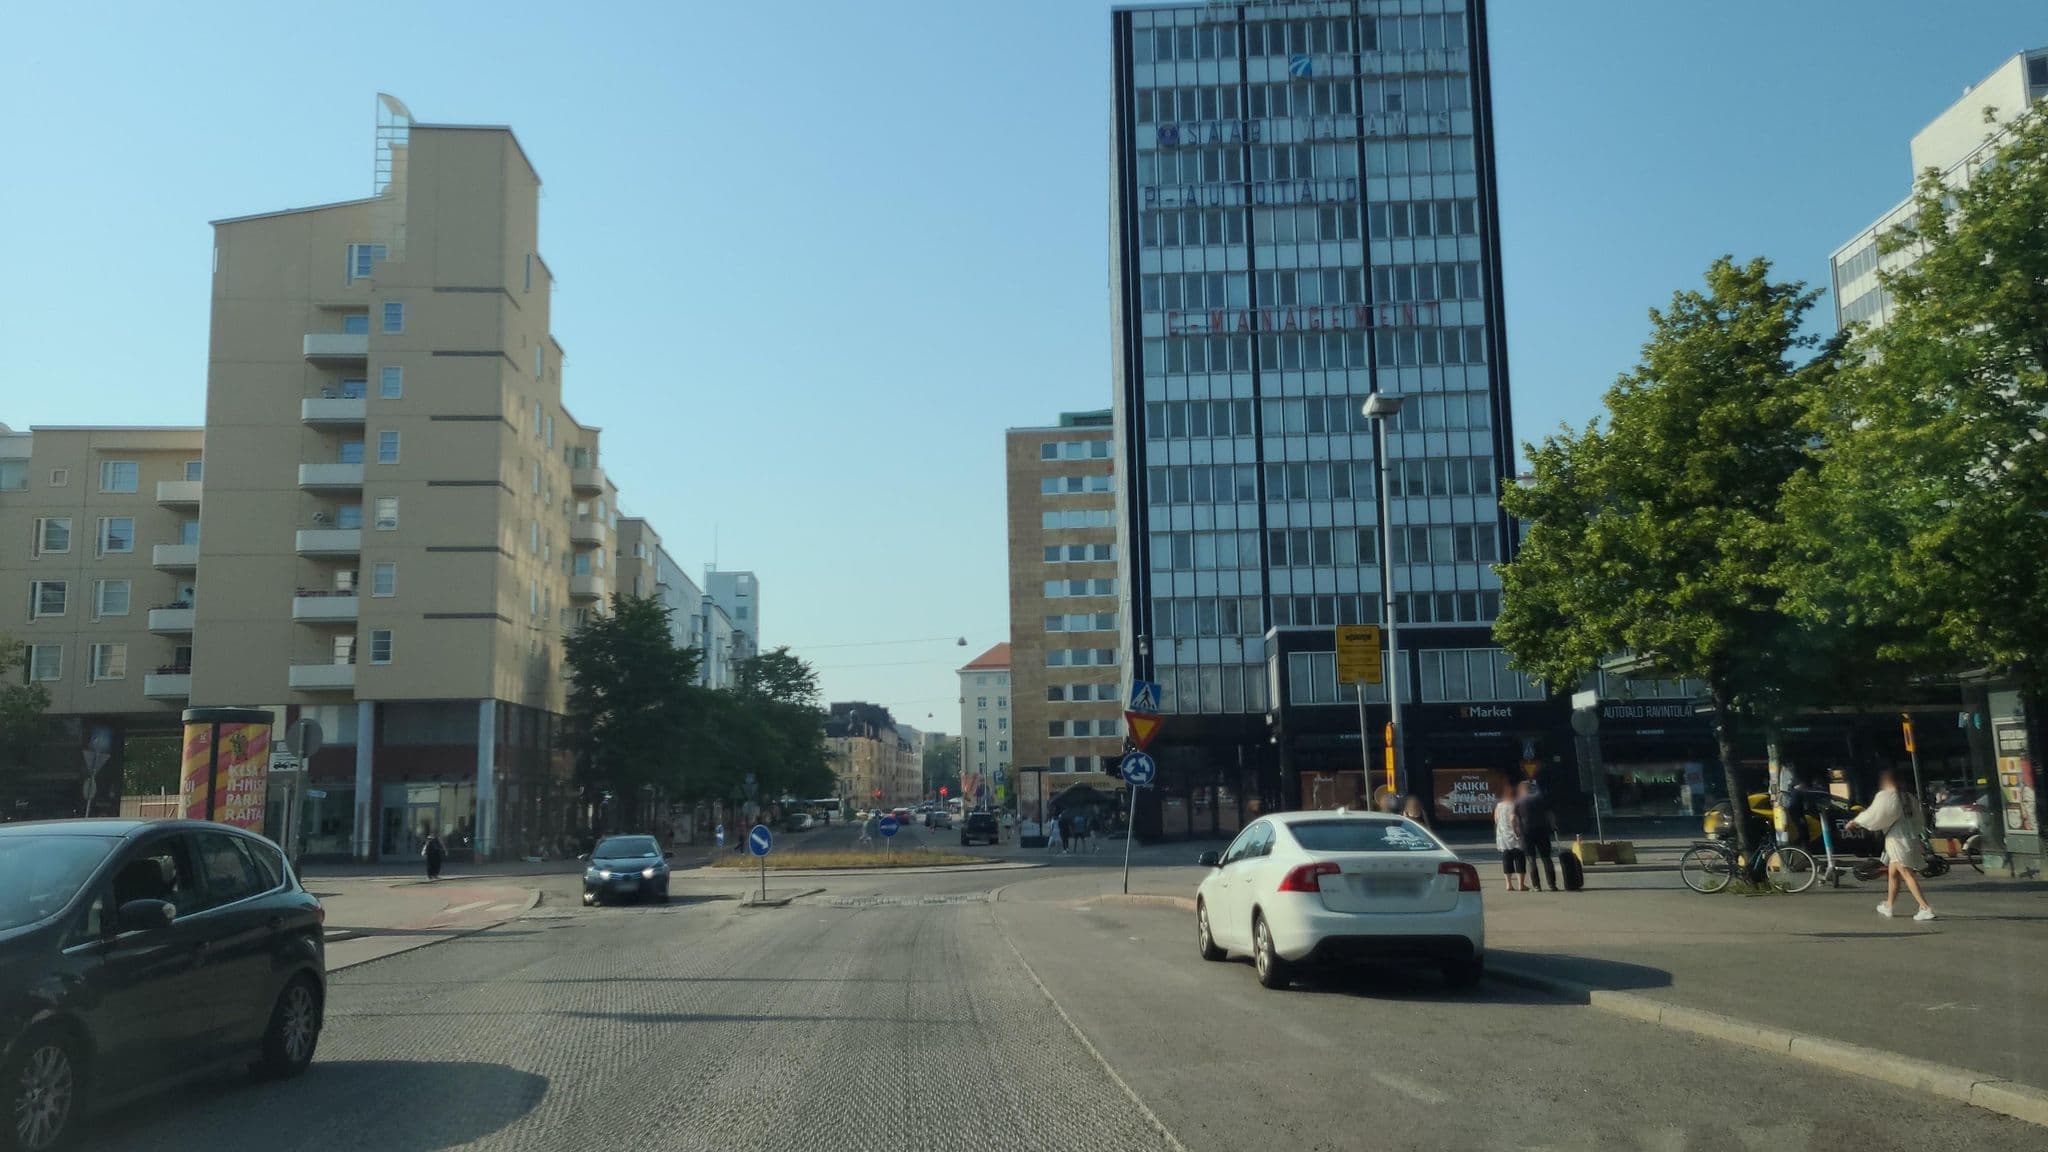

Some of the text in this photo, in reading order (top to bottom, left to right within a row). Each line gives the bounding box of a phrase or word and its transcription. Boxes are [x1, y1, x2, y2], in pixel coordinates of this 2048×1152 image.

[1187, 120, 1261, 144] SAAB
[1145, 178, 1357, 208] P-AUTOTALO
[1604, 705, 1693, 718] AUTOTALO RAVINTOLAT
[1454, 781, 1489, 791] KAIKKI
